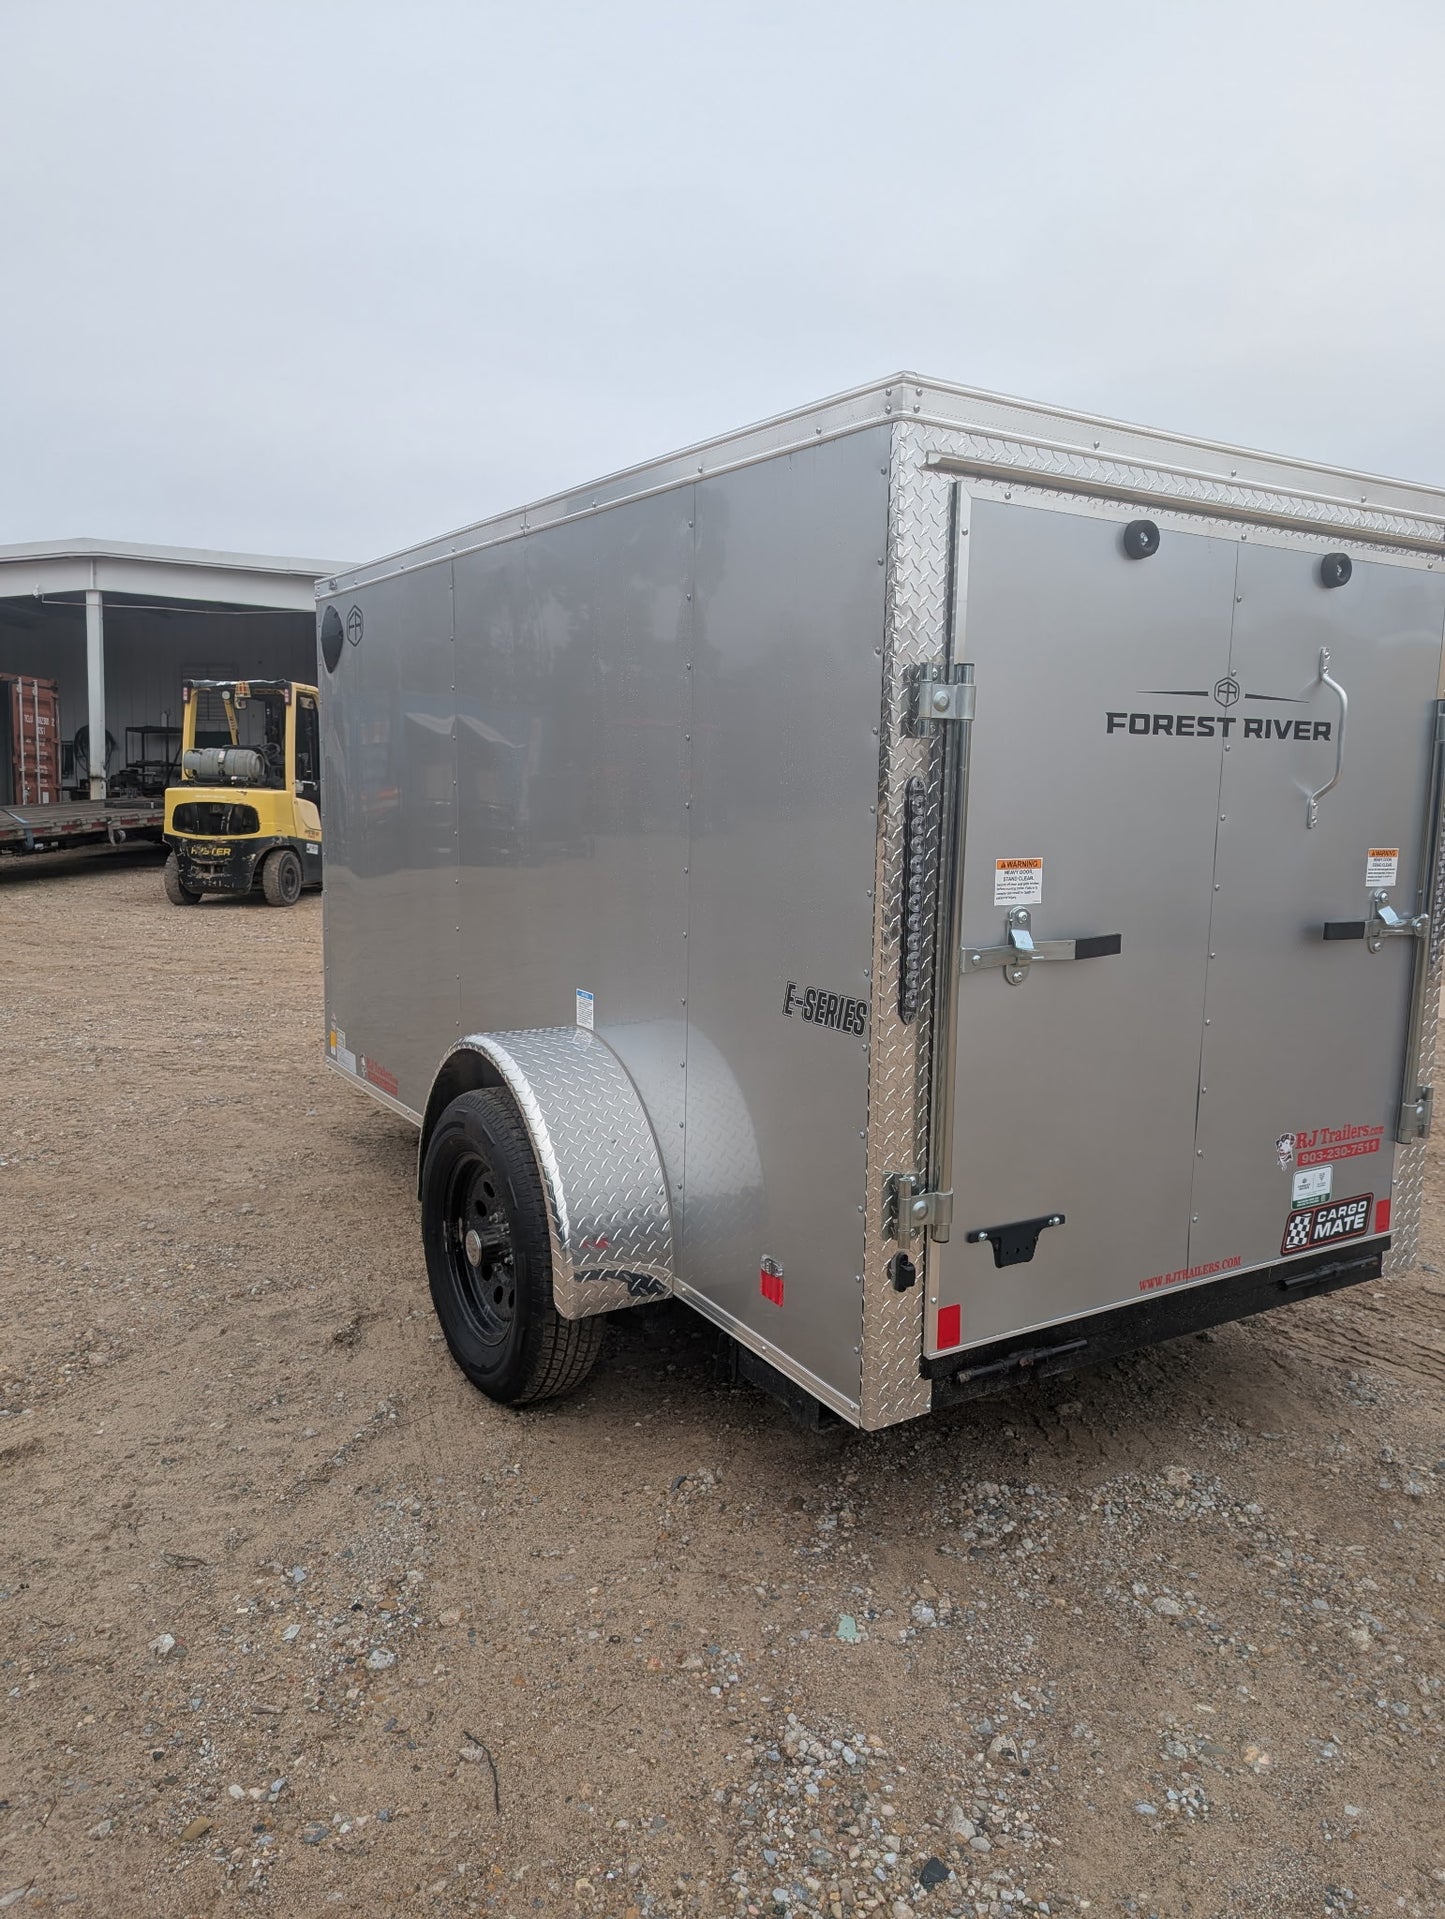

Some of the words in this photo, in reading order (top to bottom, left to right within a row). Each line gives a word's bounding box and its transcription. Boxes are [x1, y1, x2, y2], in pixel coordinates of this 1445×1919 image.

[1105, 712, 1236, 738] FOREST
[1243, 718, 1332, 741] RIVER
[1007, 860, 1038, 868] WARNING
[782, 980, 869, 1038] E-SERIES
[1295, 1129, 1319, 1149] RJ
[1302, 1140, 1378, 1164] 903-230-7511
[1316, 1200, 1368, 1223] CARGO
[1313, 1212, 1366, 1240] MATE
